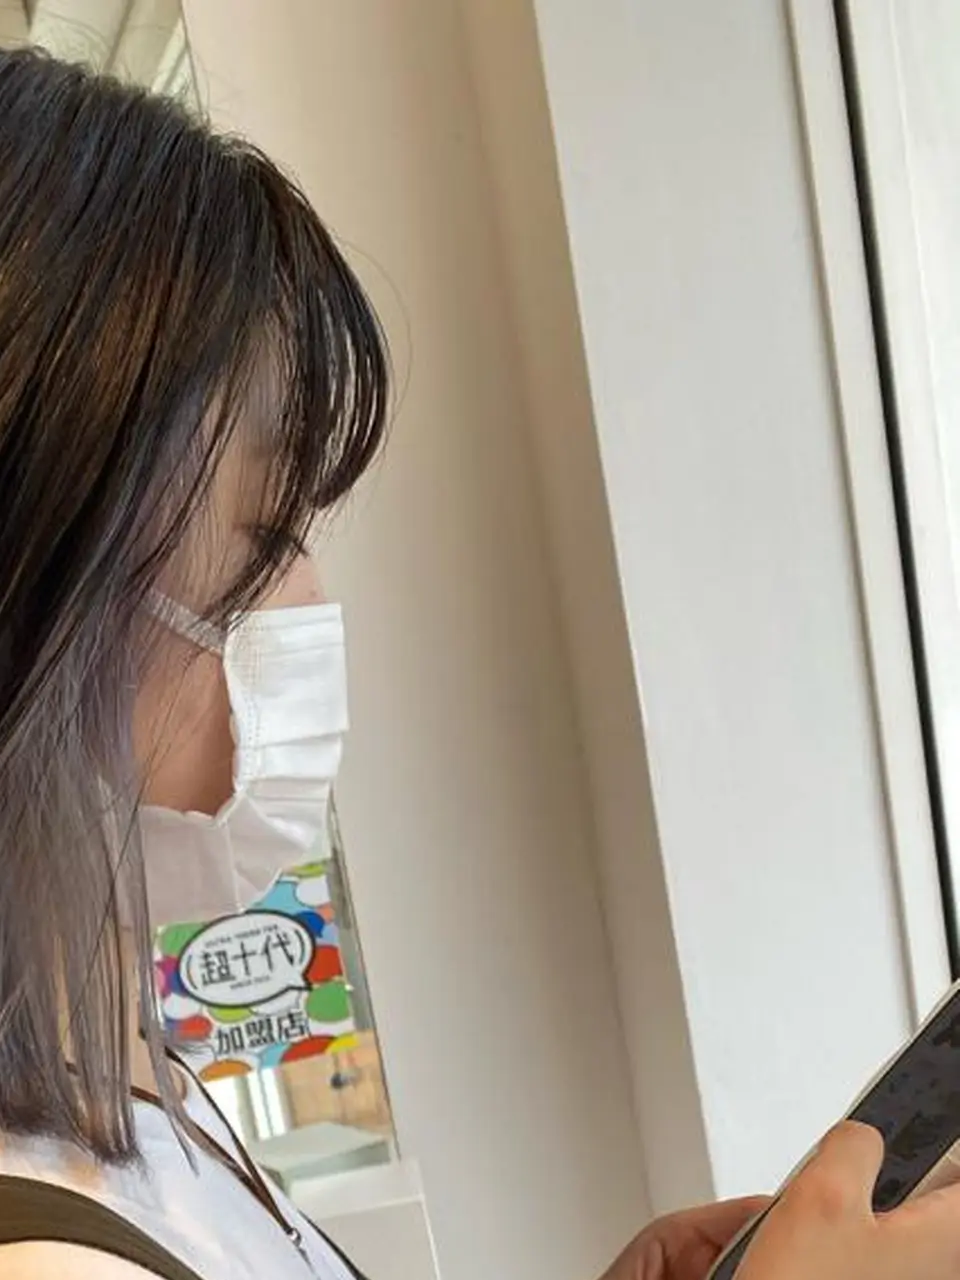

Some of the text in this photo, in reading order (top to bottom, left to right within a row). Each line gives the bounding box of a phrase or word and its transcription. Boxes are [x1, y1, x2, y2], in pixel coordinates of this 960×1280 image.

[200, 931, 295, 986] 超十代
[217, 1012, 305, 1055] 加盟店
